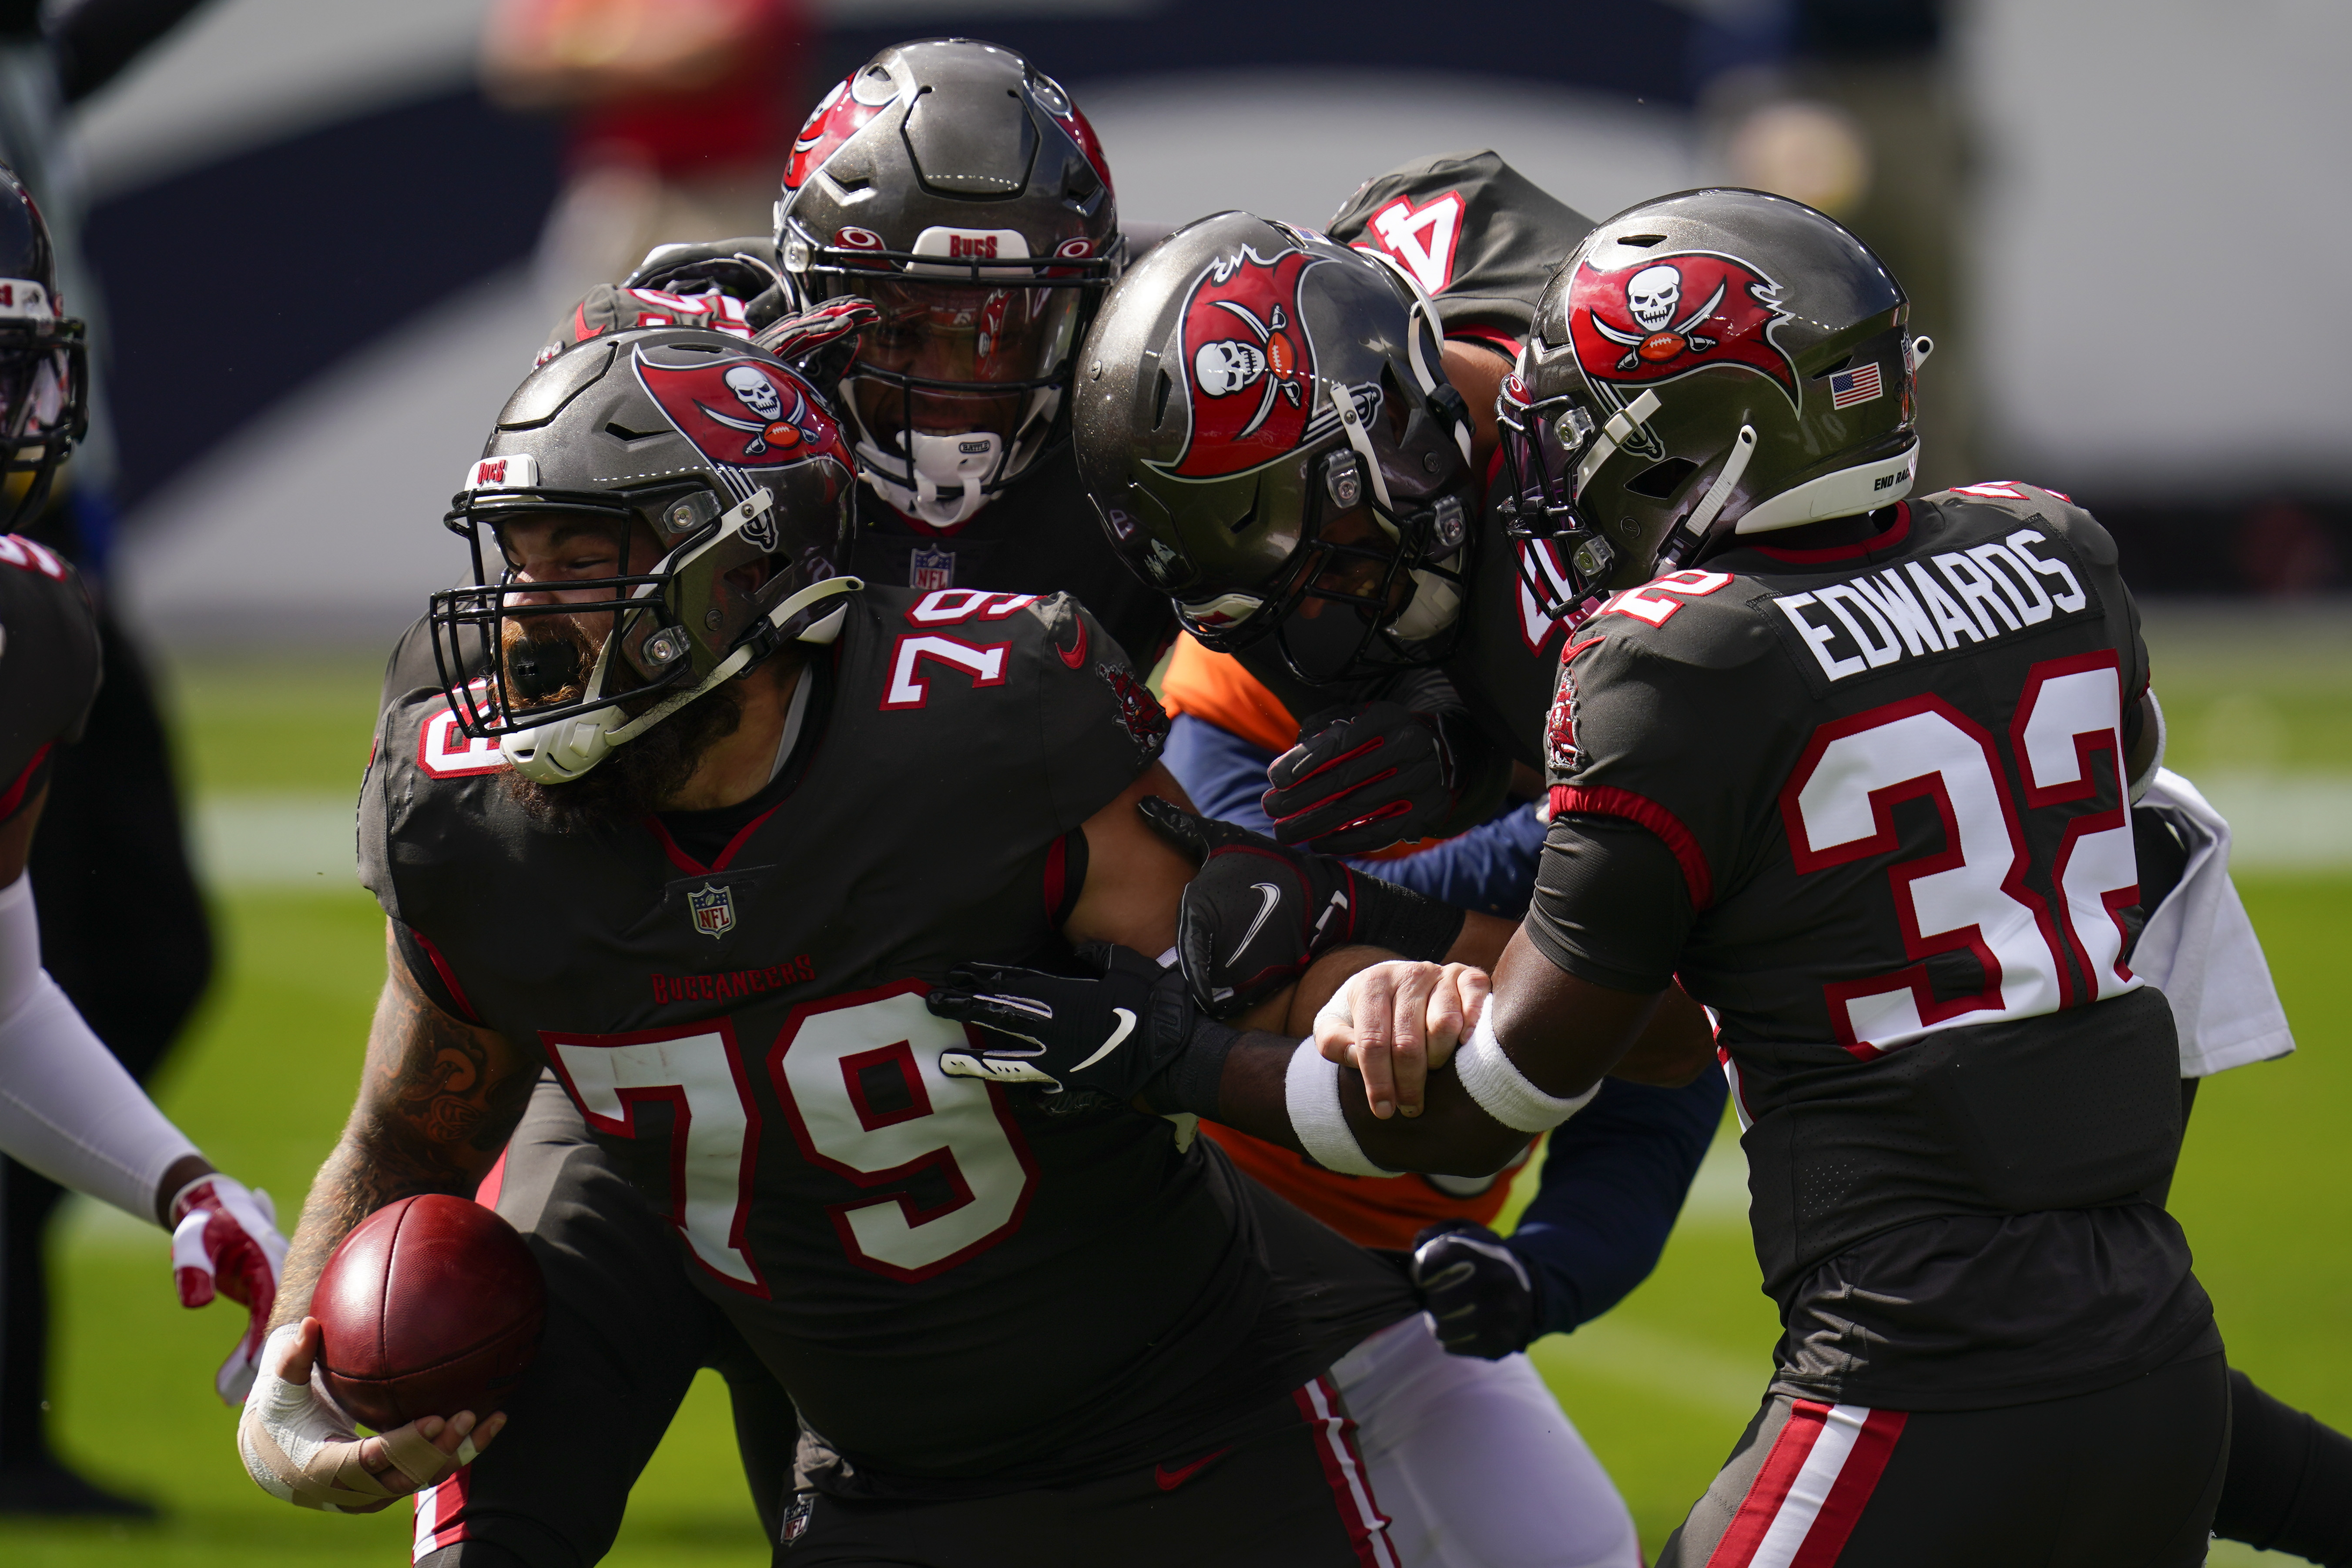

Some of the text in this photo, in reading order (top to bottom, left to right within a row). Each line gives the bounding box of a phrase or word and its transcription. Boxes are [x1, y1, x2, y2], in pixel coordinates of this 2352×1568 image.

[949, 235, 997, 258] BUCS
[962, 442, 988, 451] BATTLE
[477, 459, 507, 485] BUCS
[1874, 475, 1894, 491] END
[917, 569, 946, 589] NFL
[1772, 528, 2086, 682] EDWARDS
[1777, 647, 2144, 1062] 32
[698, 907, 730, 929] NFL
[650, 954, 815, 1006] BUCCANEERS
[537, 976, 1041, 1301] 79
[785, 1518, 804, 1539] NFL
